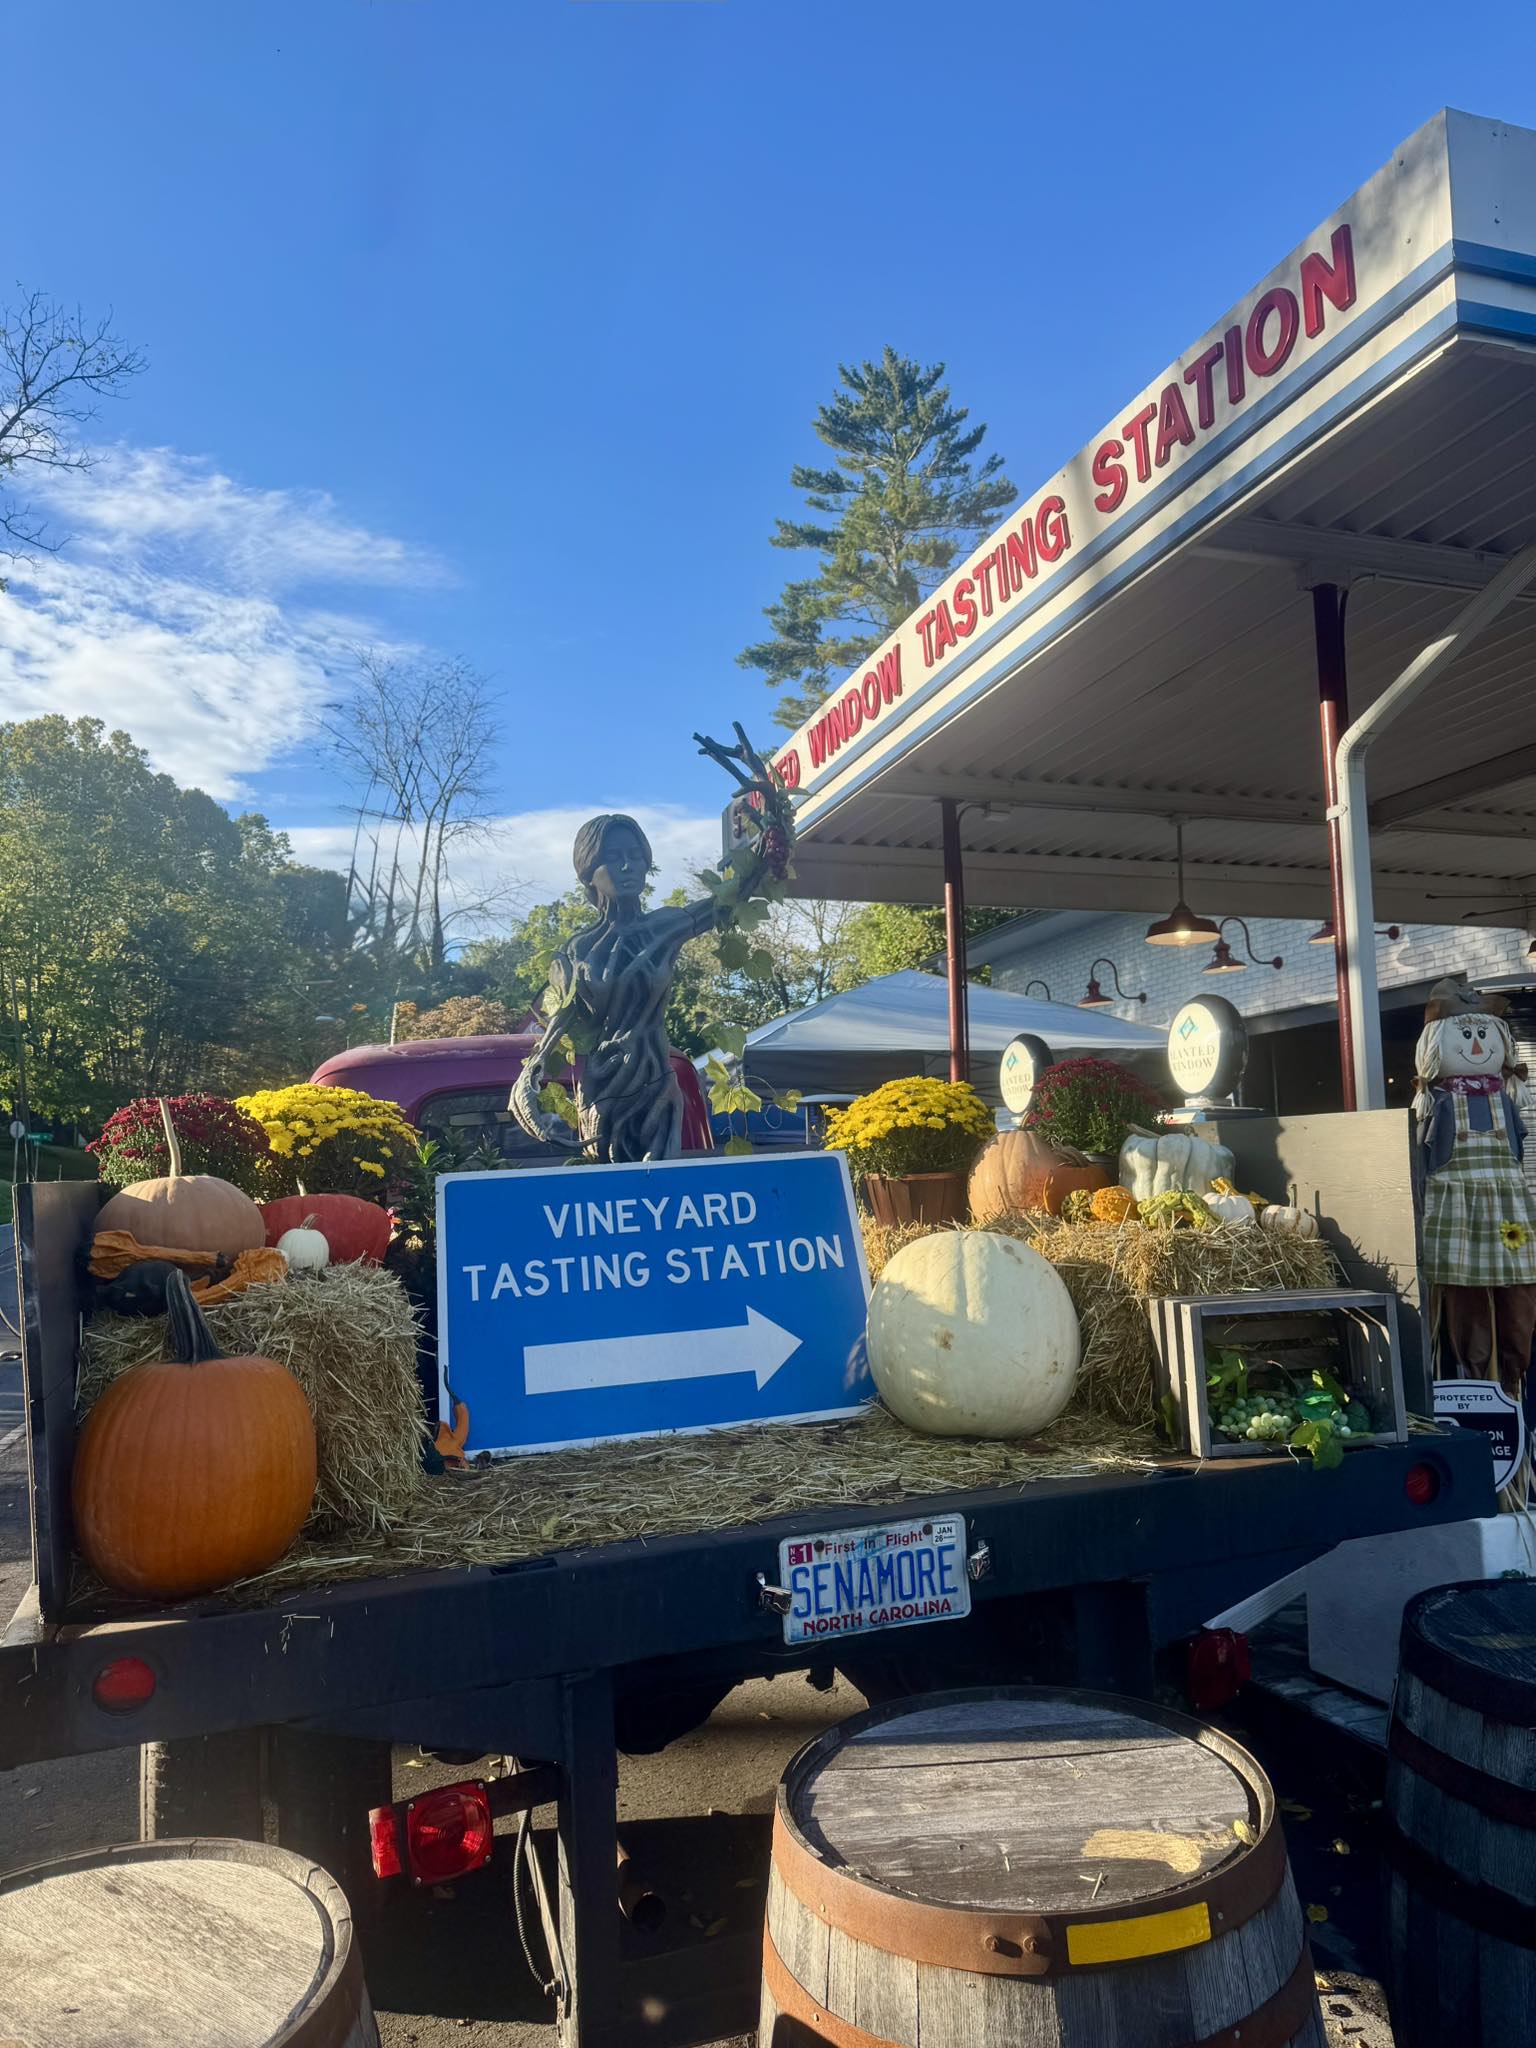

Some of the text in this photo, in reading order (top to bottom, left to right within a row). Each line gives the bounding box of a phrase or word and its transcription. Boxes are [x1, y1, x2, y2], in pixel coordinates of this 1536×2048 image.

[808, 222, 1357, 770] WINDOW TASTING STATION
[543, 1191, 758, 1239] VINEYARD
[462, 1234, 846, 1302] TASTING STATION
[1433, 1394, 1493, 1402] PROTECTED
[1457, 1402, 1470, 1410] BY
[824, 1530, 924, 1556] First in Flight
[936, 1526, 953, 1535] JAN
[799, 1545, 809, 1563] 1
[791, 1543, 958, 1618] SENAMORE
[803, 1598, 952, 1637] NORTH CAROLINA
